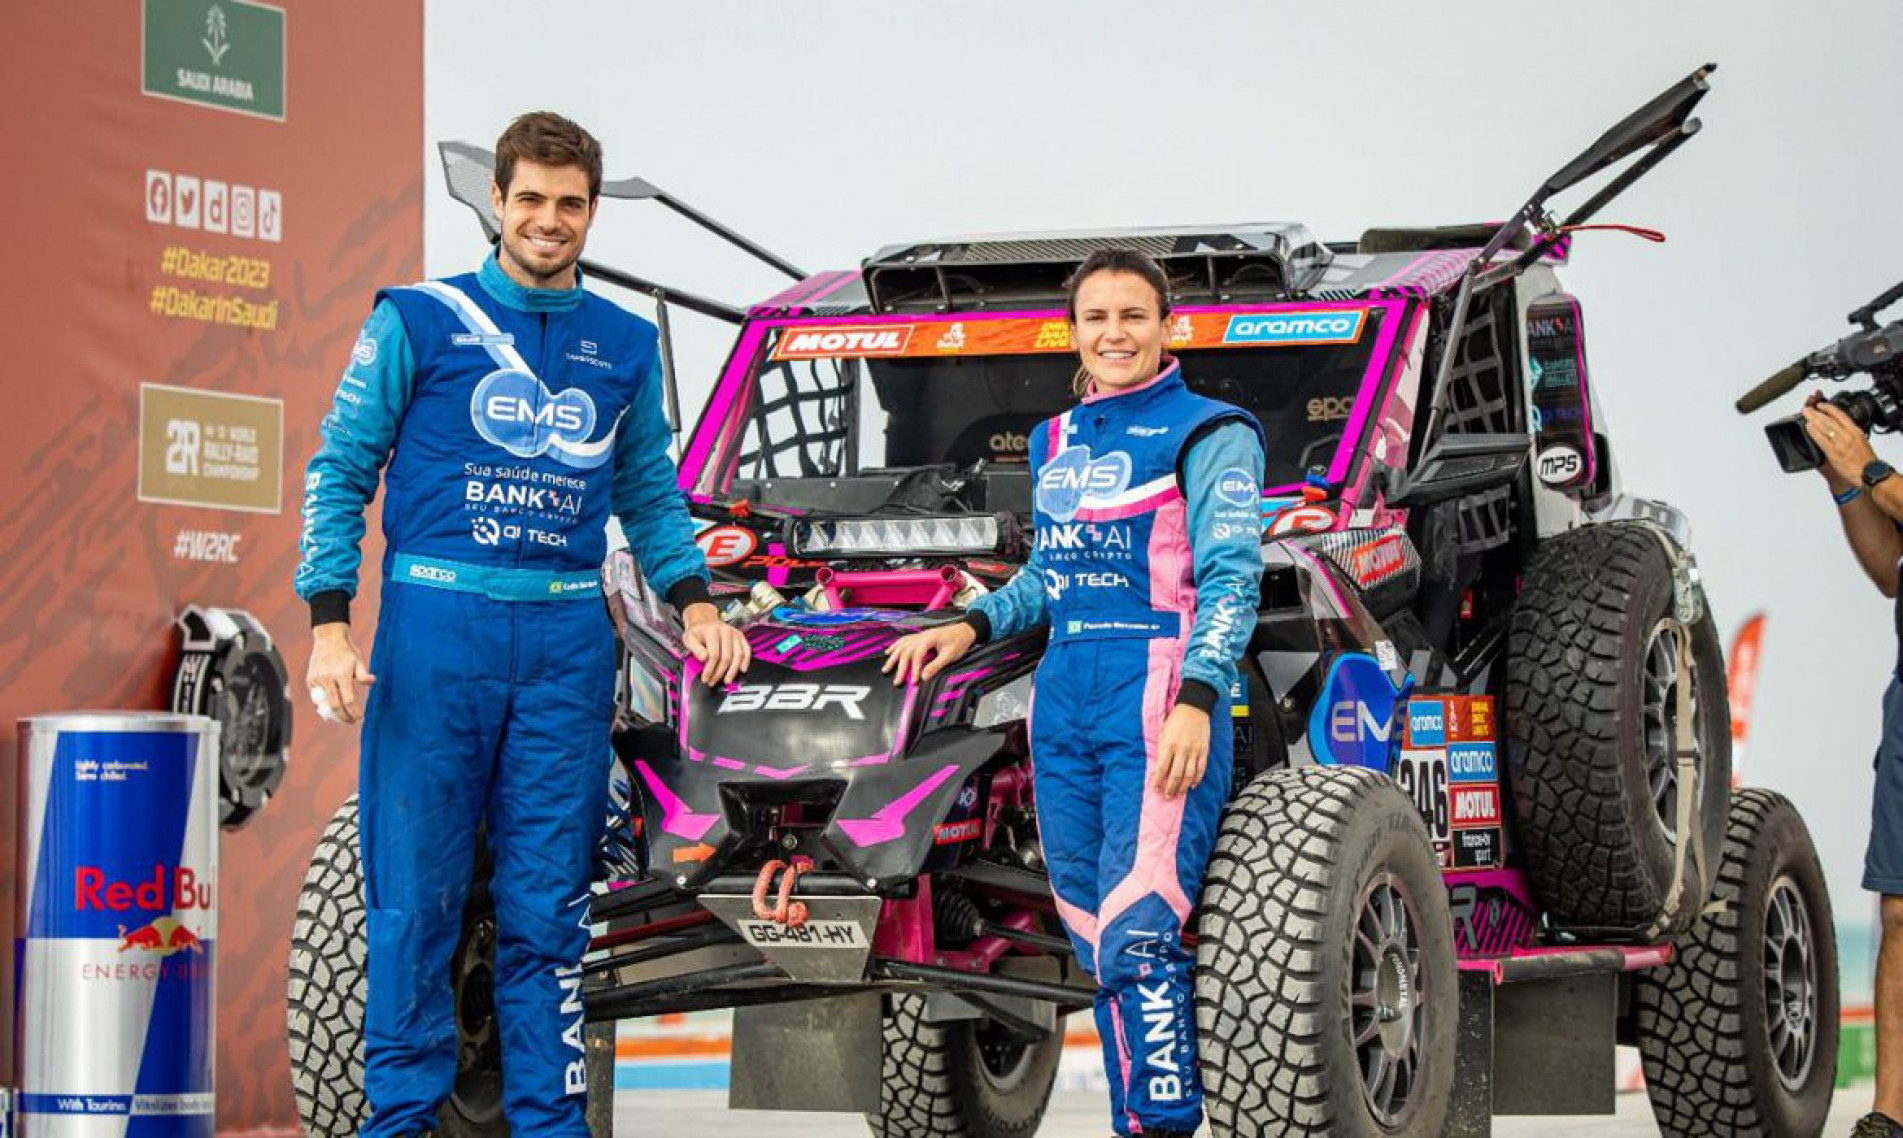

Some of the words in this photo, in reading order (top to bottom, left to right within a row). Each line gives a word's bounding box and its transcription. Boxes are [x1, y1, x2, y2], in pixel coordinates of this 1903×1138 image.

[177, 68, 211, 92] SAUDI
[213, 74, 254, 101] ARABIA
[162, 247, 270, 289] #Dakar2023
[1234, 315, 1350, 335] aramco
[788, 332, 902, 351] MOTUL
[487, 396, 582, 430] EMS
[464, 463, 492, 477] Sua
[495, 466, 539, 482] saúde
[542, 472, 587, 491] merece
[1041, 464, 1120, 490] EMS
[1540, 454, 1577, 476] MPS
[466, 481, 547, 509] BANK
[559, 494, 583, 515] AI
[174, 530, 242, 563] #W2RC
[527, 529, 568, 547] TECH
[1103, 526, 1131, 549] AI
[1075, 572, 1129, 588] TECH
[717, 684, 872, 720] BBR
[1411, 715, 1444, 731] aramco
[1451, 752, 1493, 773] aramco
[1455, 792, 1496, 819] MOTUL
[76, 865, 164, 911] Red
[748, 925, 854, 944] GG-481-HY
[1124, 930, 1159, 958] AI
[82, 963, 169, 981] ENERGY
[1137, 982, 1182, 1100] BANK
[57, 1098, 84, 1112] With
[87, 1098, 126, 1112] Taurine.
